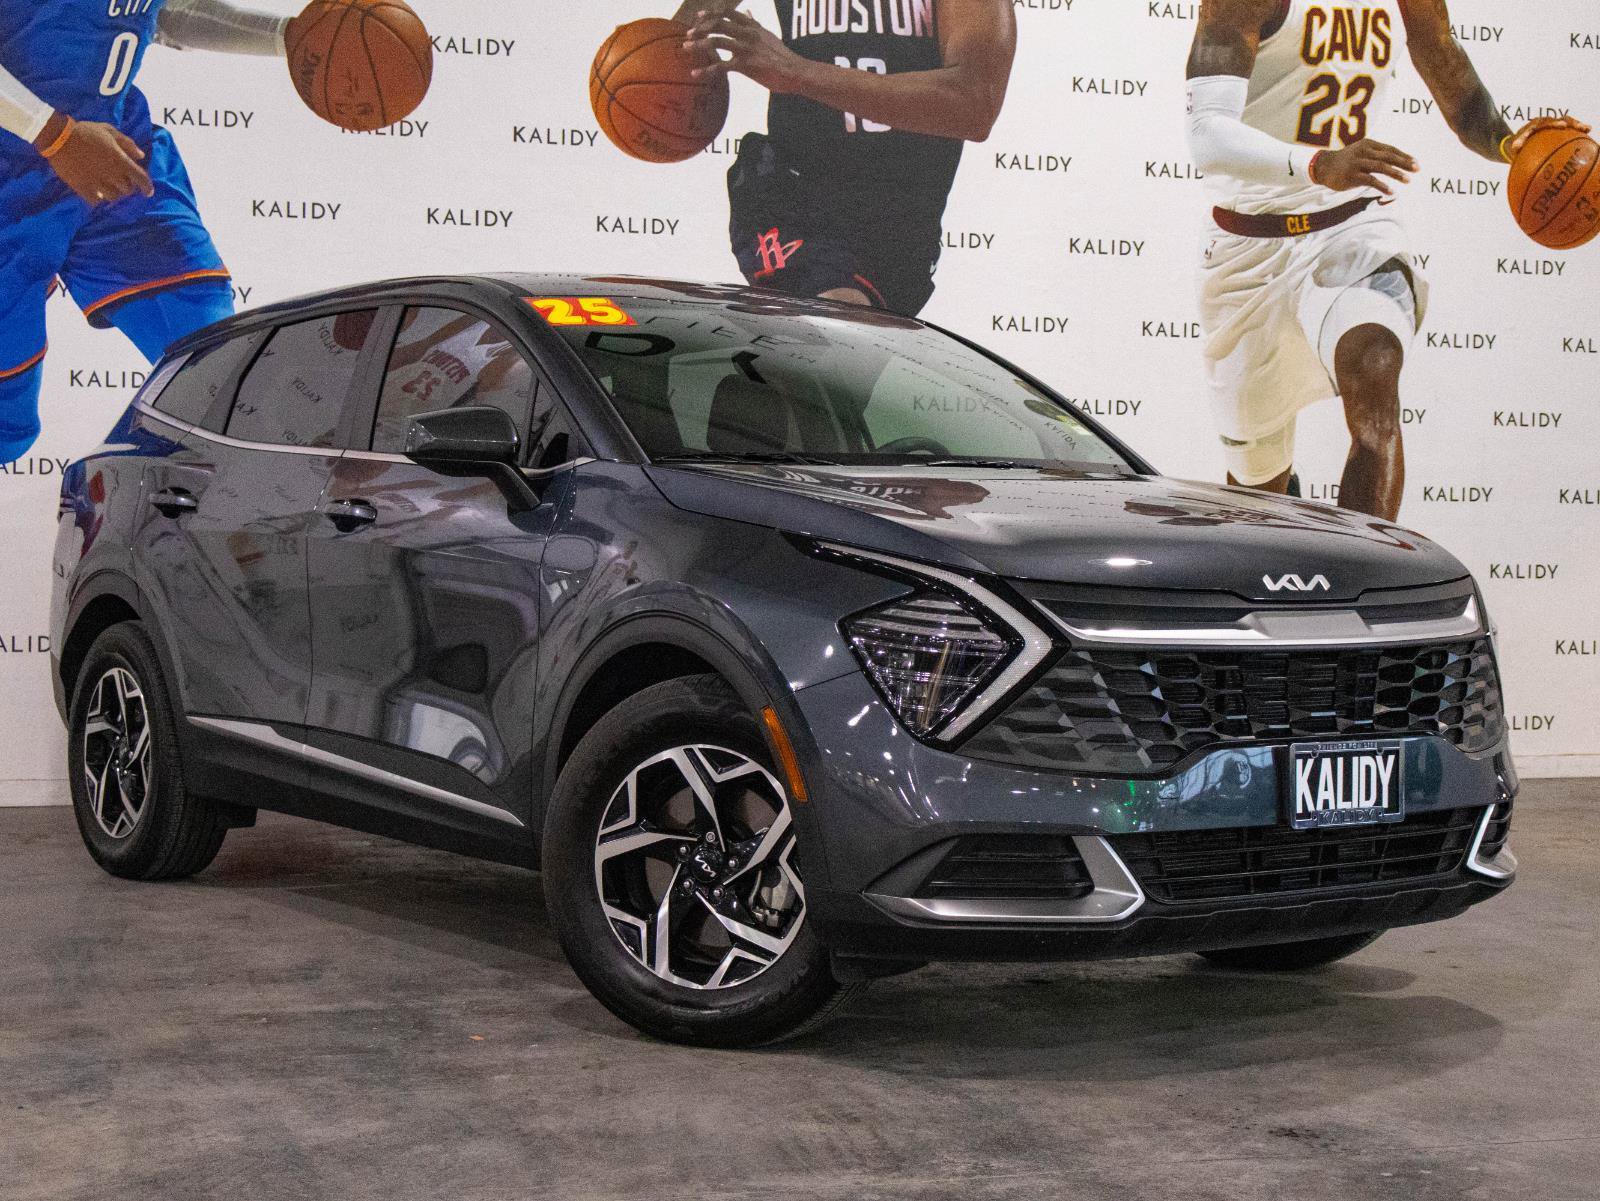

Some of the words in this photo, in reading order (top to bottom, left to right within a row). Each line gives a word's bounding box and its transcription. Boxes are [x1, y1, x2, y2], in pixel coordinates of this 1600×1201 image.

[1149, 2, 1194, 19] KALI
[791, 0, 934, 40] HOUSTON
[1300, 5, 1392, 69] CAVS
[1449, 25, 1503, 42] ALIDY
[1571, 33, 1600, 49] KAL
[430, 36, 514, 56] KALIDY
[99, 32, 138, 96] 0
[1073, 77, 1148, 96] KALIDY
[1296, 73, 1375, 147] 23
[1393, 100, 1433, 114] IDY
[164, 108, 254, 128] KALIDY
[514, 127, 597, 146] KALIDY
[996, 153, 1073, 171] KALIDY
[1431, 178, 1500, 195] KALIDY
[253, 200, 342, 220] KALIDY
[427, 208, 513, 227] KALIDY
[597, 216, 679, 235] KALIDY
[1286, 215, 1311, 234] CLE
[939, 232, 994, 249] LIDY
[1070, 238, 1144, 256] KALIDY
[1498, 259, 1565, 276] KALIDY
[532, 298, 628, 325] 25
[993, 315, 1068, 334] KALIDY
[1142, 321, 1200, 338] KALID
[1427, 333, 1496, 350] KALIDY
[1563, 338, 1597, 353] KAL
[70, 370, 147, 388] KALID
[1494, 411, 1562, 427] KALIDY
[0, 458, 69, 475] ALIDY
[1311, 484, 1340, 499] LID
[1424, 487, 1492, 502] KALIDY
[1560, 489, 1600, 504] KALI
[1490, 564, 1558, 579] KALIDY
[1556, 640, 1597, 655] KALI
[1513, 716, 1554, 730] LIDY
[1296, 754, 1396, 814] KALIDY
